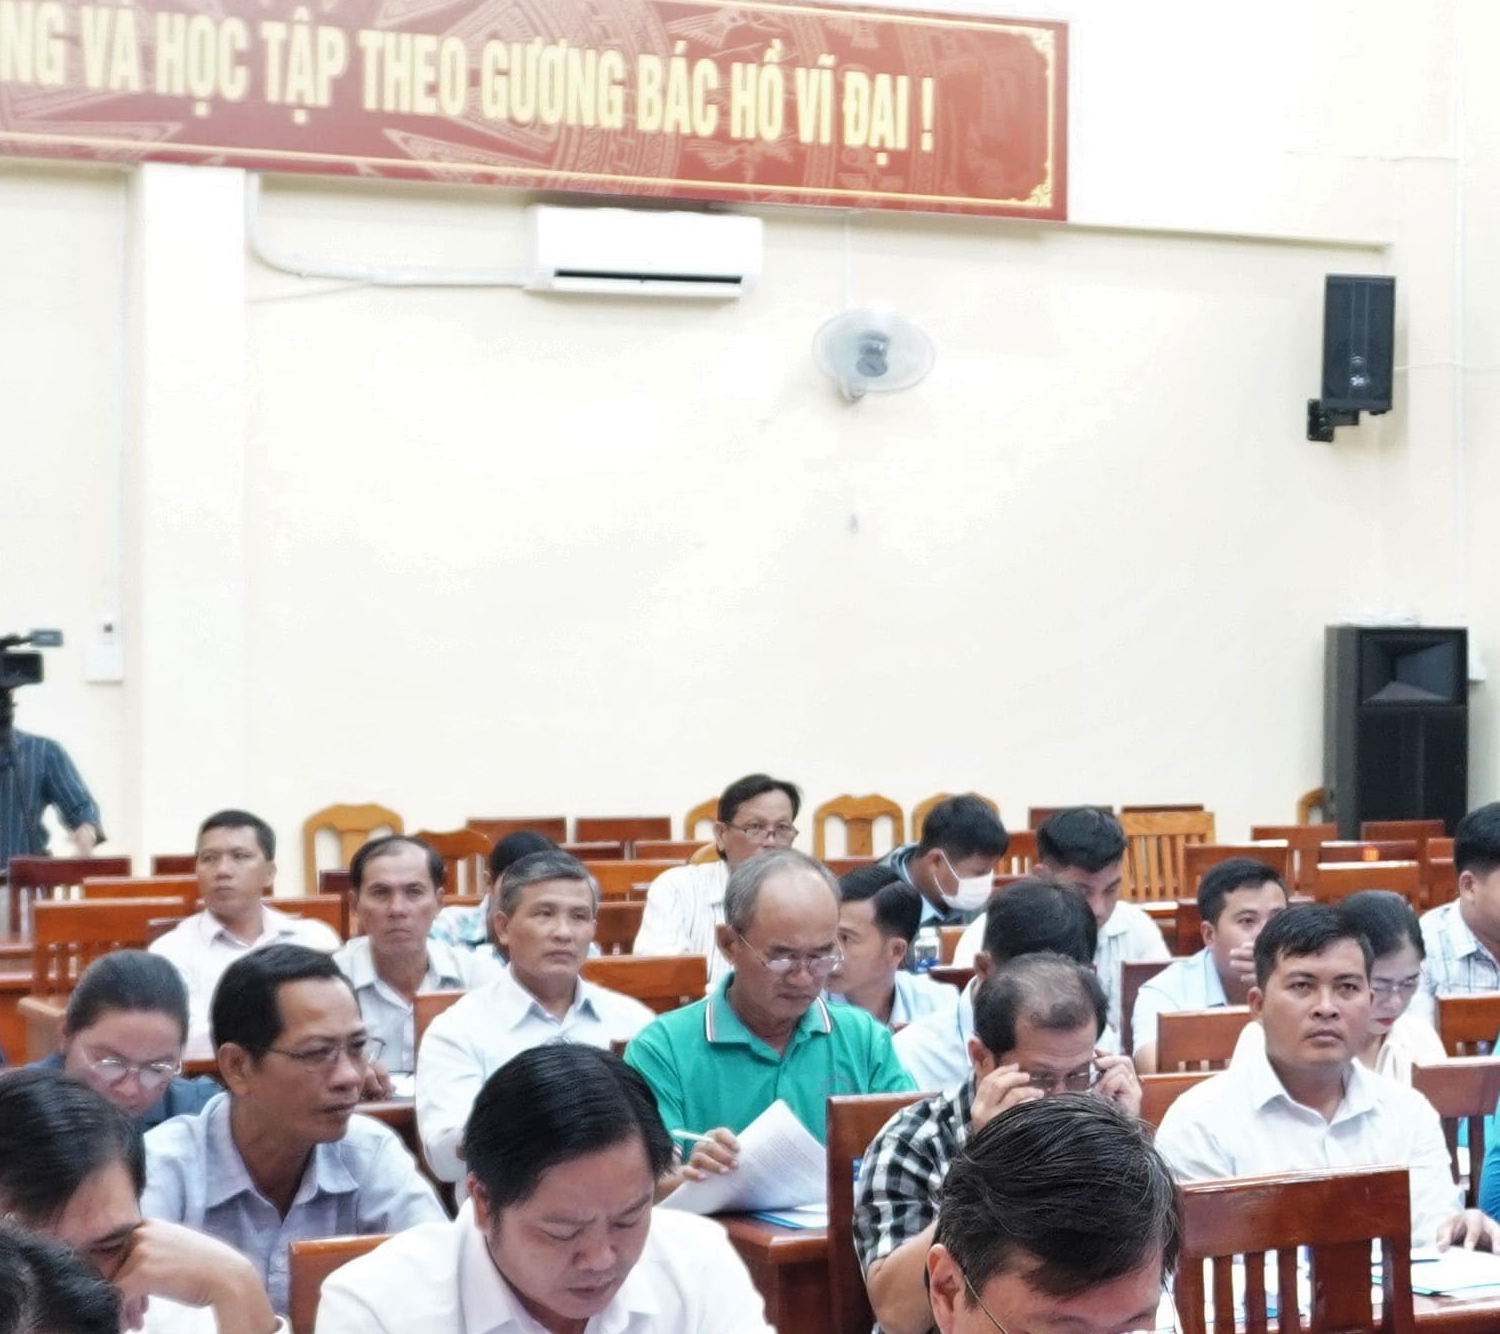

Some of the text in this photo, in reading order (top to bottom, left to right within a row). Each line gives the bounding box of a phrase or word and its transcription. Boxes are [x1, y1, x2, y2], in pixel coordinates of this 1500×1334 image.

[154, 11, 250, 118] HỌC
[259, 5, 348, 125] TẬP
[357, 28, 468, 116] THEO
[480, 35, 626, 130] GƯƠNG
[636, 39, 720, 137] BÁC
[729, 38, 784, 142] HỒ
[794, 53, 837, 145] VĨ
[842, 70, 909, 167] ĐẠI
